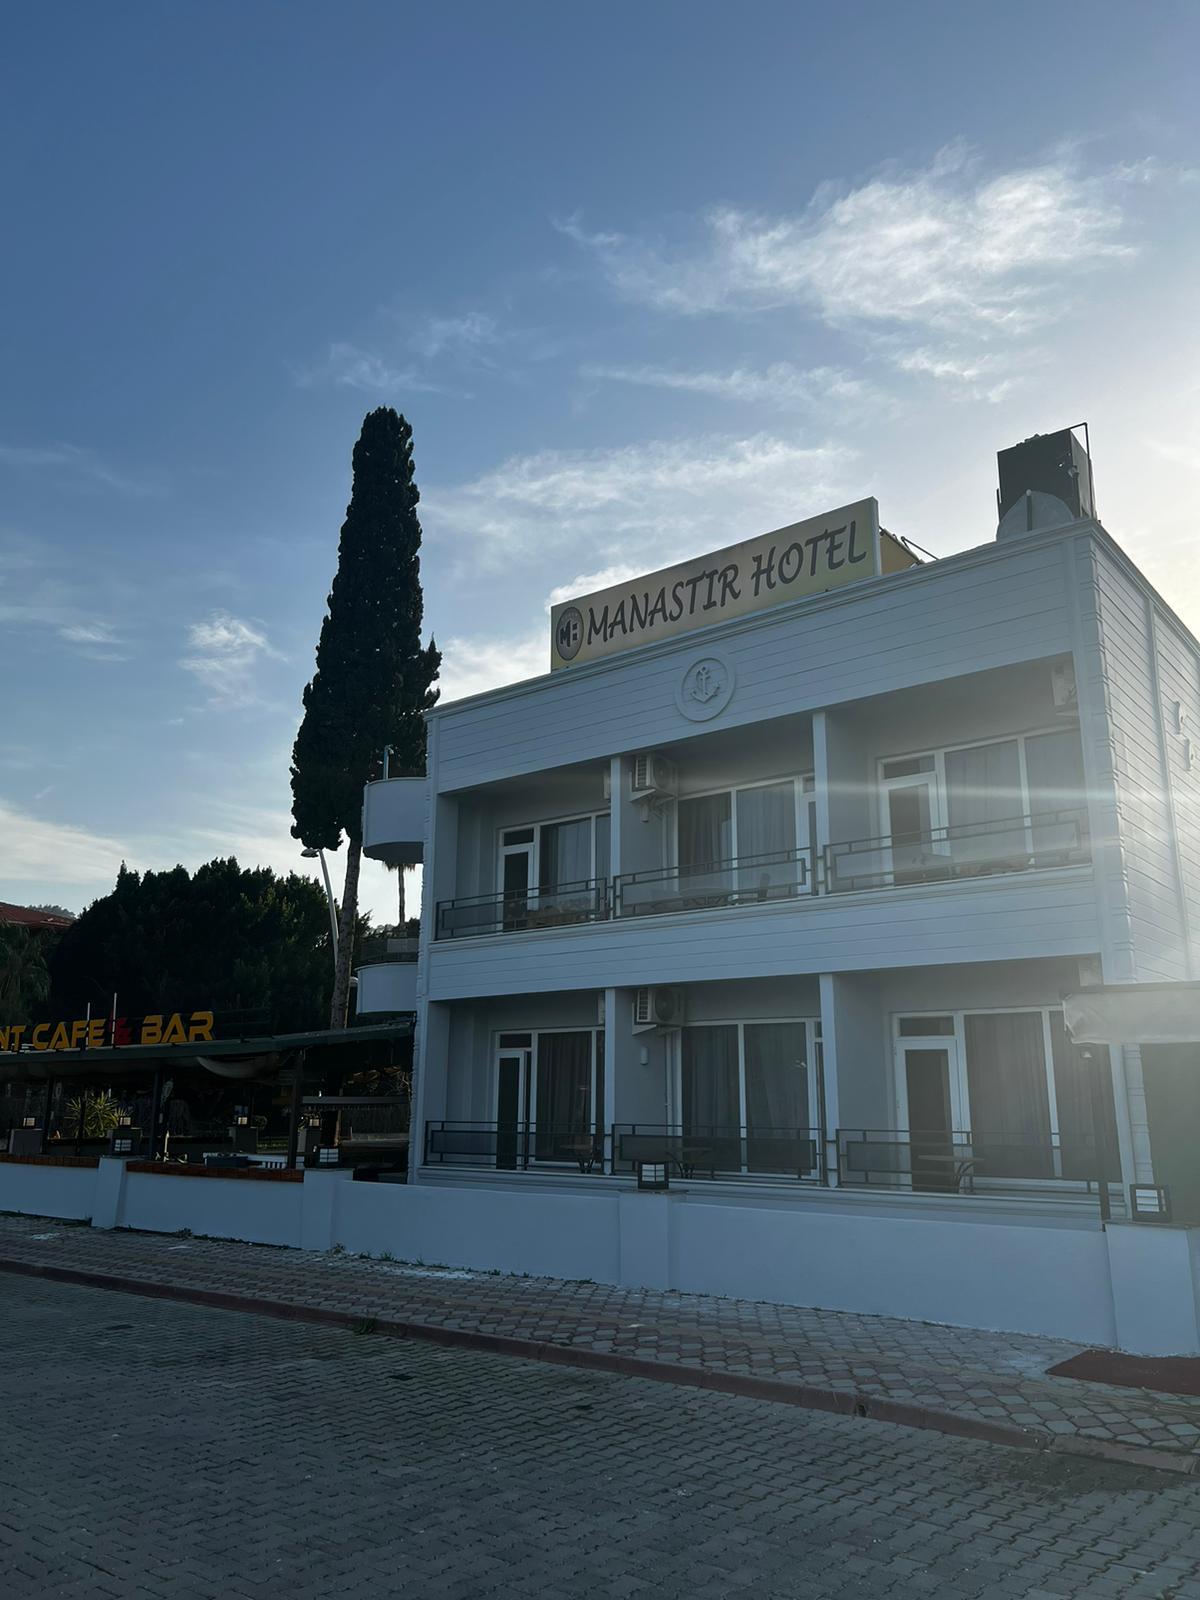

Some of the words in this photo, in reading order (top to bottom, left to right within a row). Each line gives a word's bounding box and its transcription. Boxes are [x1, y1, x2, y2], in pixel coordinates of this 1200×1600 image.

[587, 563, 741, 645] MANASTIR
[750, 520, 867, 597] HOTEL
[32, 1018, 107, 1050] CAFE
[140, 1011, 214, 1046] BAR
